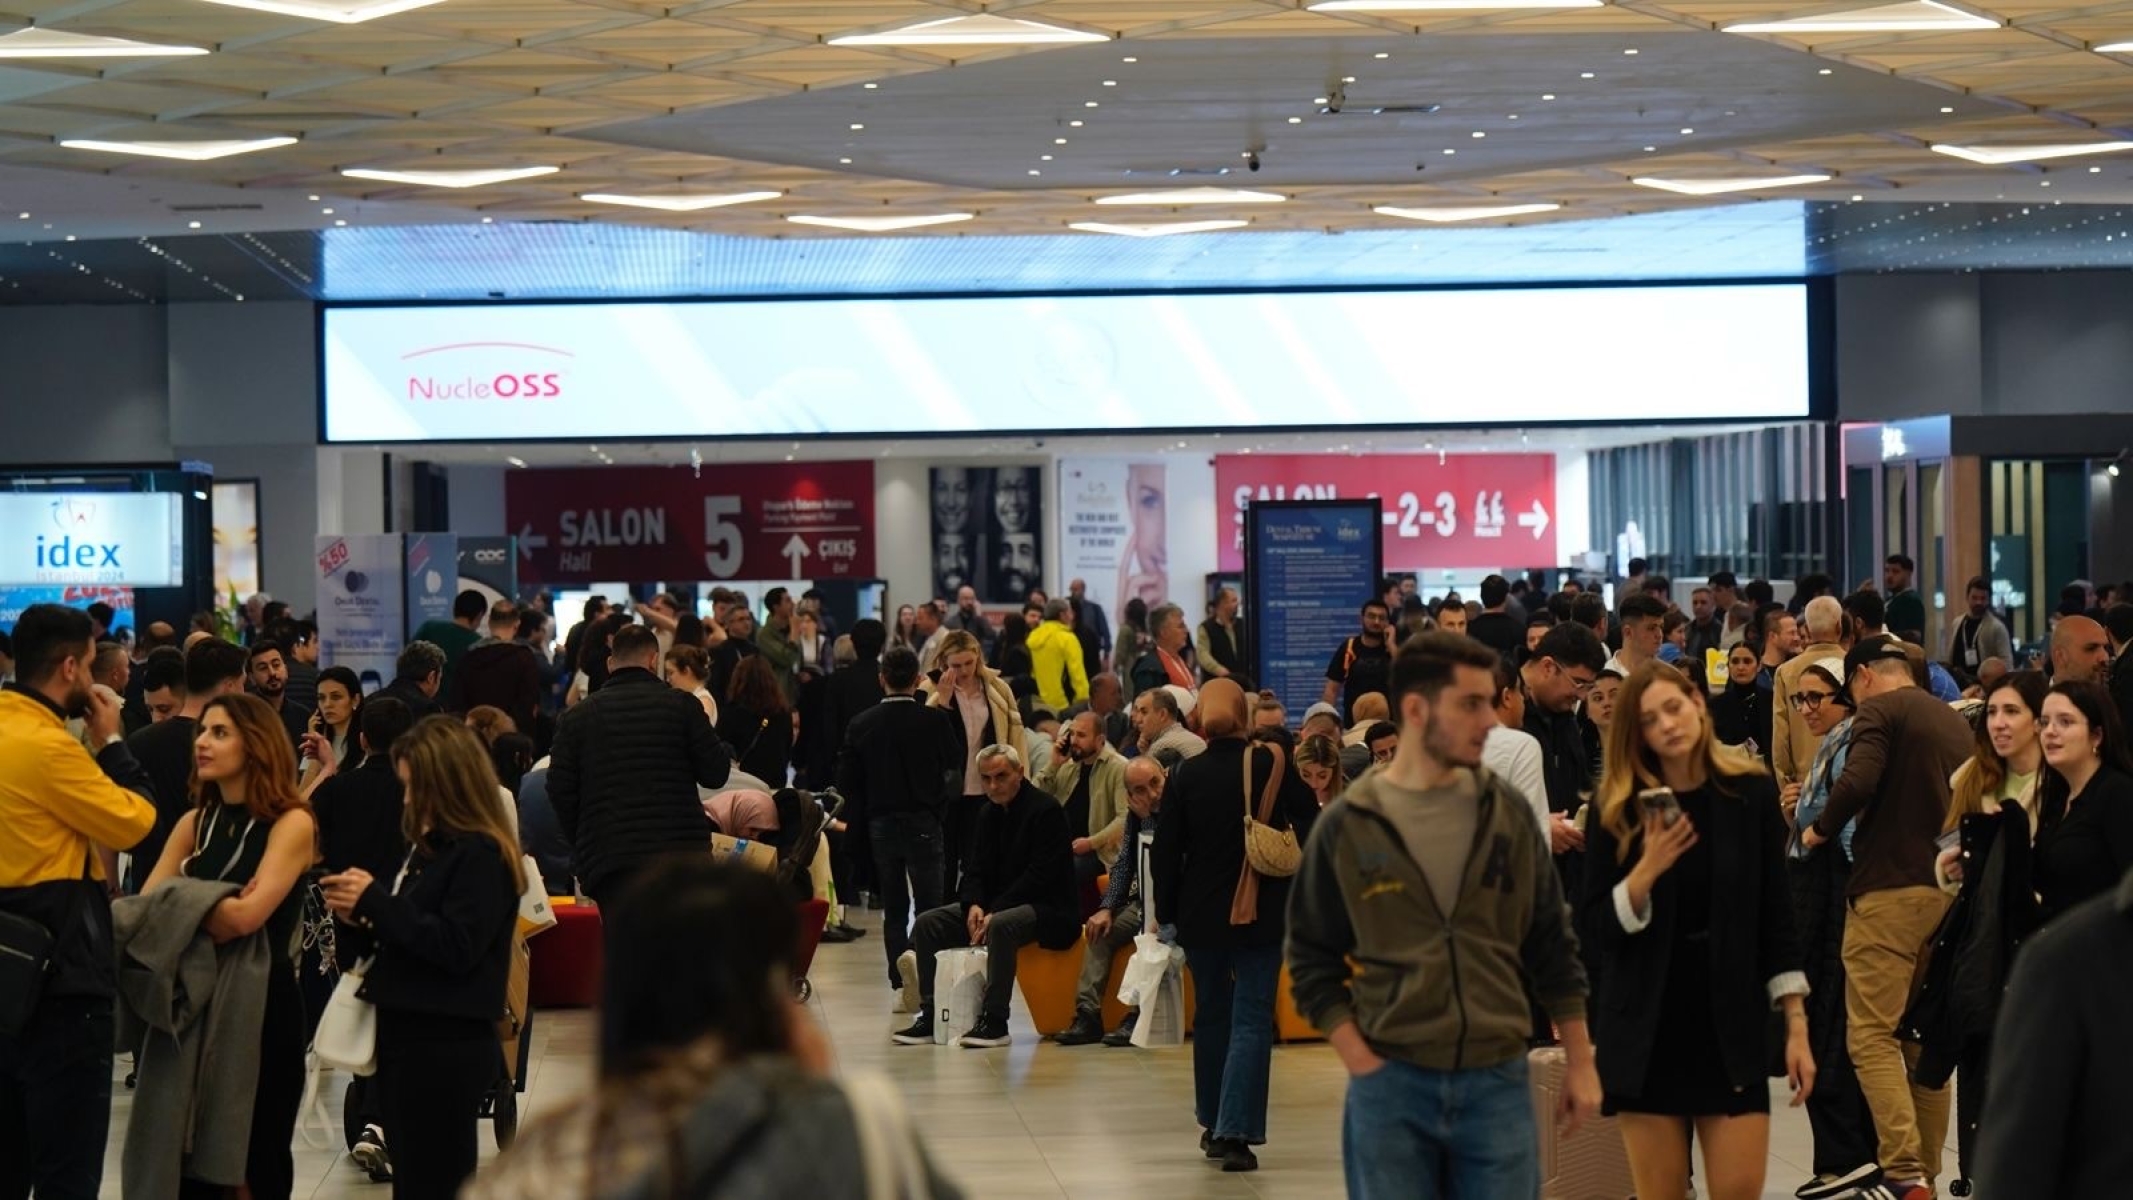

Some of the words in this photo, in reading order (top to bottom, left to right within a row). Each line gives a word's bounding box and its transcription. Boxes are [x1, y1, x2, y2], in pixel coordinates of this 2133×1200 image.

[408, 373, 561, 400] NucleOSS
[559, 508, 665, 546] SALON
[704, 495, 744, 579] 5
[36, 536, 121, 567] idex
[319, 541, 349, 575] %50
[560, 552, 592, 573] Hall
[818, 539, 857, 561] ÇIKIŞ
